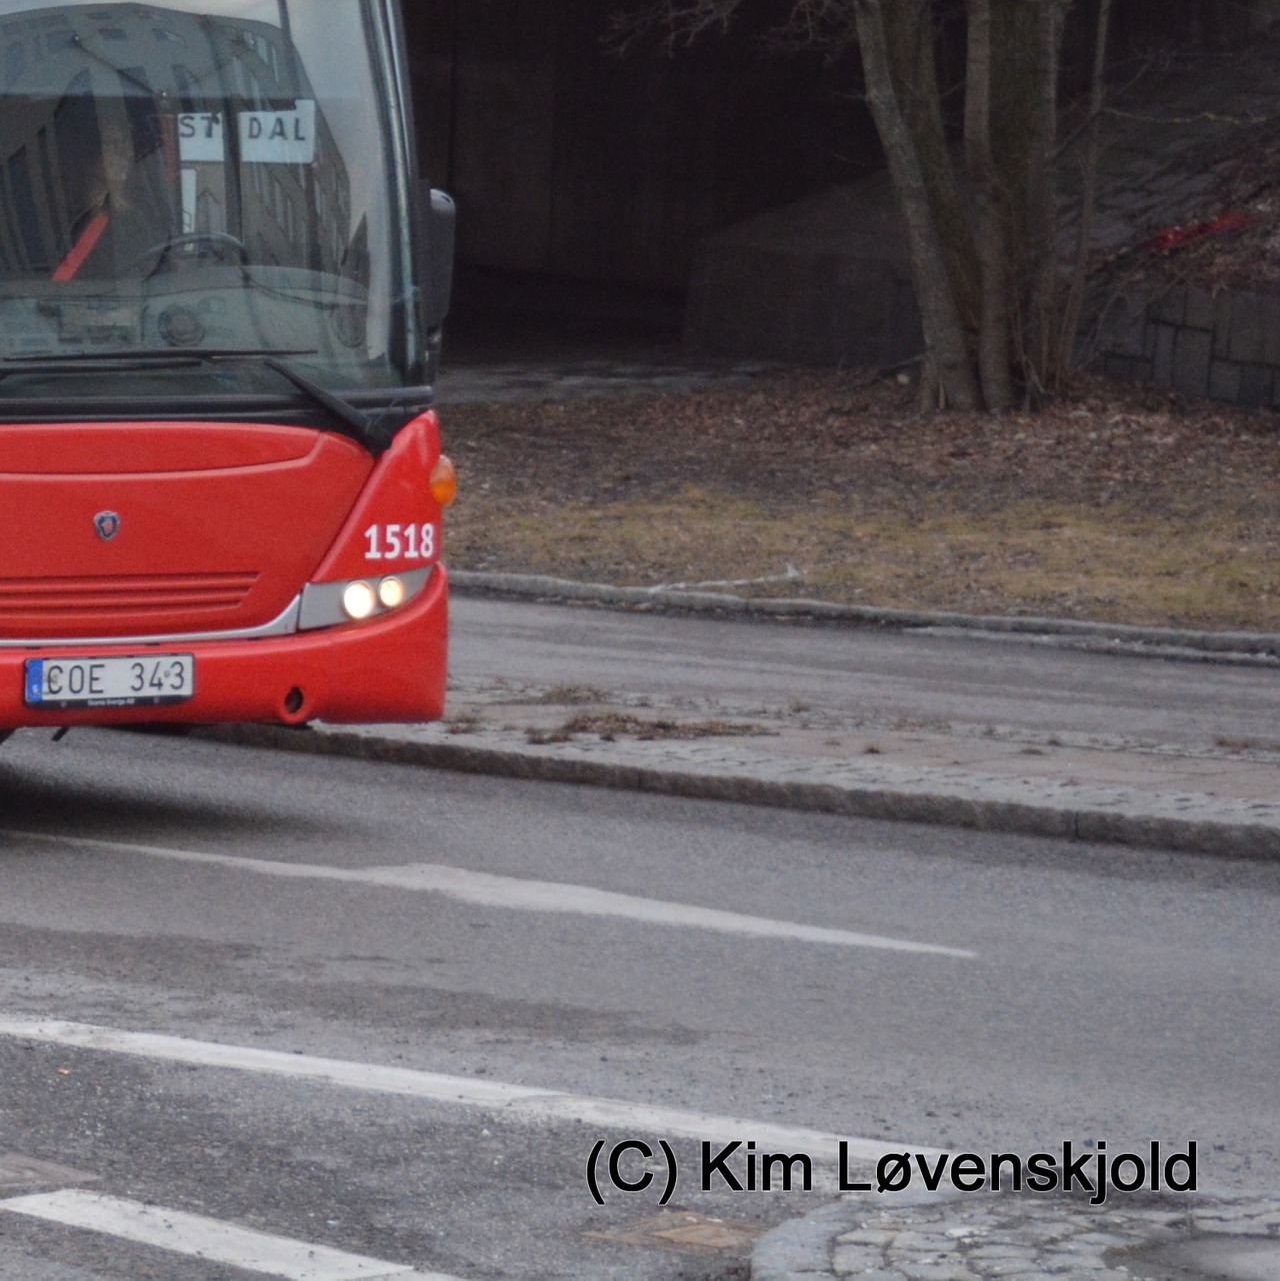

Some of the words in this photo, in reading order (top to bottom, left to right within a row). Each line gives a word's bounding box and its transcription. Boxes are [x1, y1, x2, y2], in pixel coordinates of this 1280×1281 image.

[364, 523, 434, 559] 1518
[47, 664, 106, 695] COE
[130, 661, 185, 692] 343
